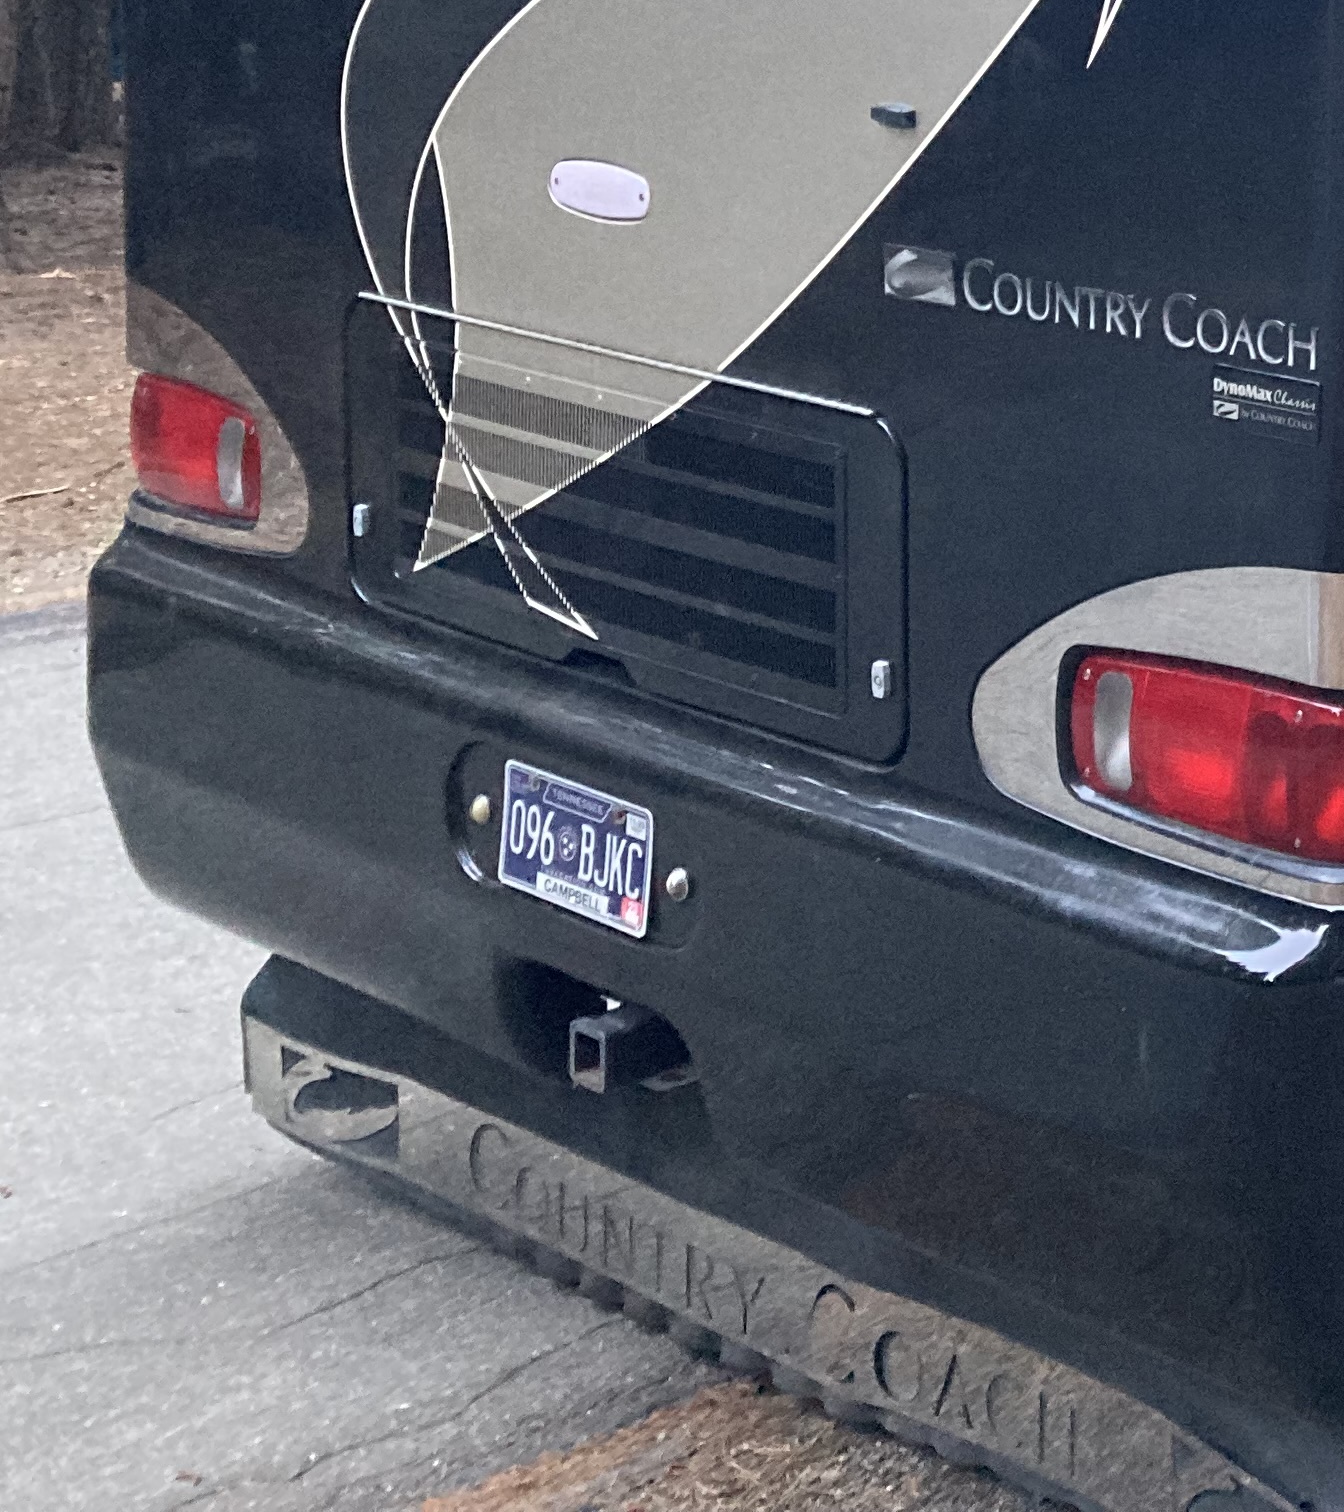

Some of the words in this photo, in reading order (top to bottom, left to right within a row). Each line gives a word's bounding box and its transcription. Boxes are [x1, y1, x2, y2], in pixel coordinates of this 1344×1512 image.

[962, 257, 1153, 340] COUNTRY
[1161, 292, 1320, 371] COACH
[1213, 377, 1272, 402] DynoMax
[509, 799, 555, 866] 096
[578, 823, 643, 900] BJKC
[543, 878, 602, 913] CAMPBELL
